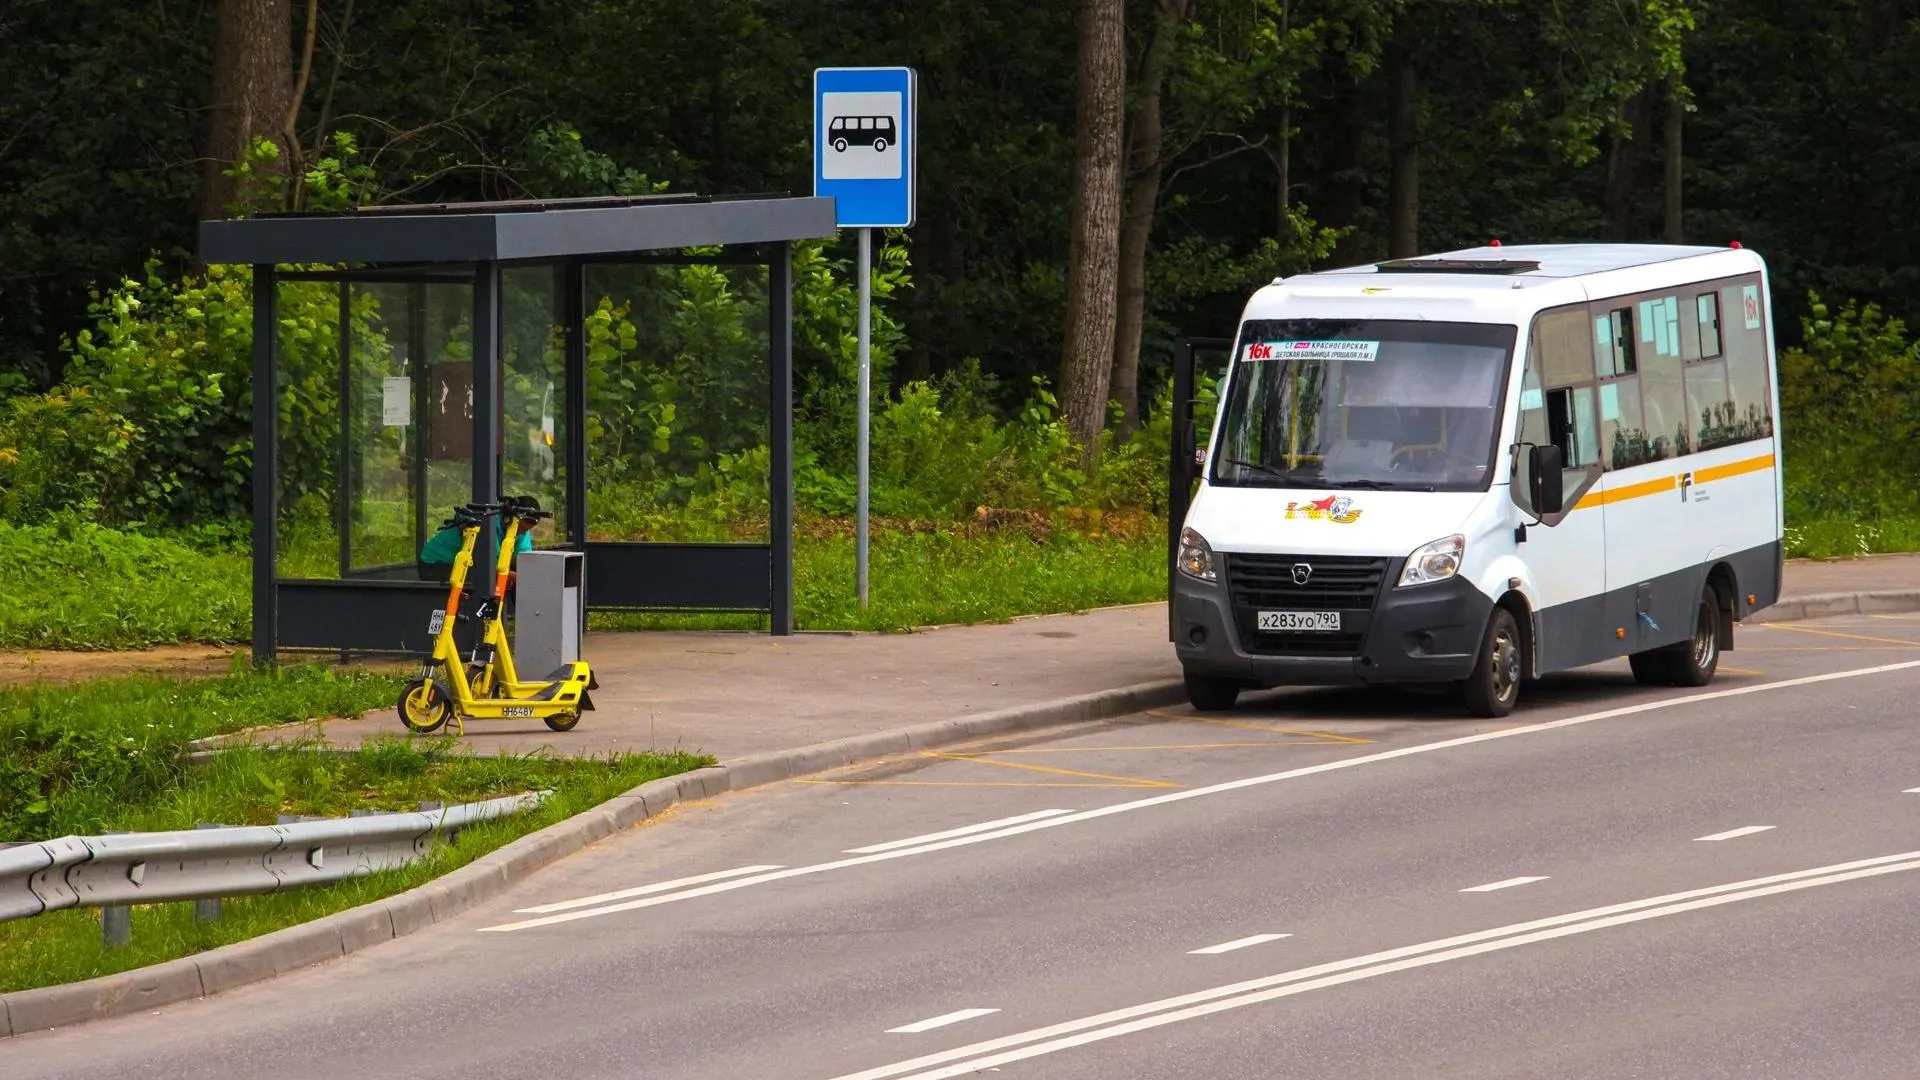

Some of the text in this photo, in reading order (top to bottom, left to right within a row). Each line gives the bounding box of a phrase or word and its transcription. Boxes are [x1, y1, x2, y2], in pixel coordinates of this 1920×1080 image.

[1311, 342, 1369, 350] КРАСНОГОРСКАЯ
[1275, 351, 1300, 359] ДЕТСКАЯ
[1300, 351, 1330, 359] БОЛЬНИЦА
[1316, 613, 1337, 624] 790
